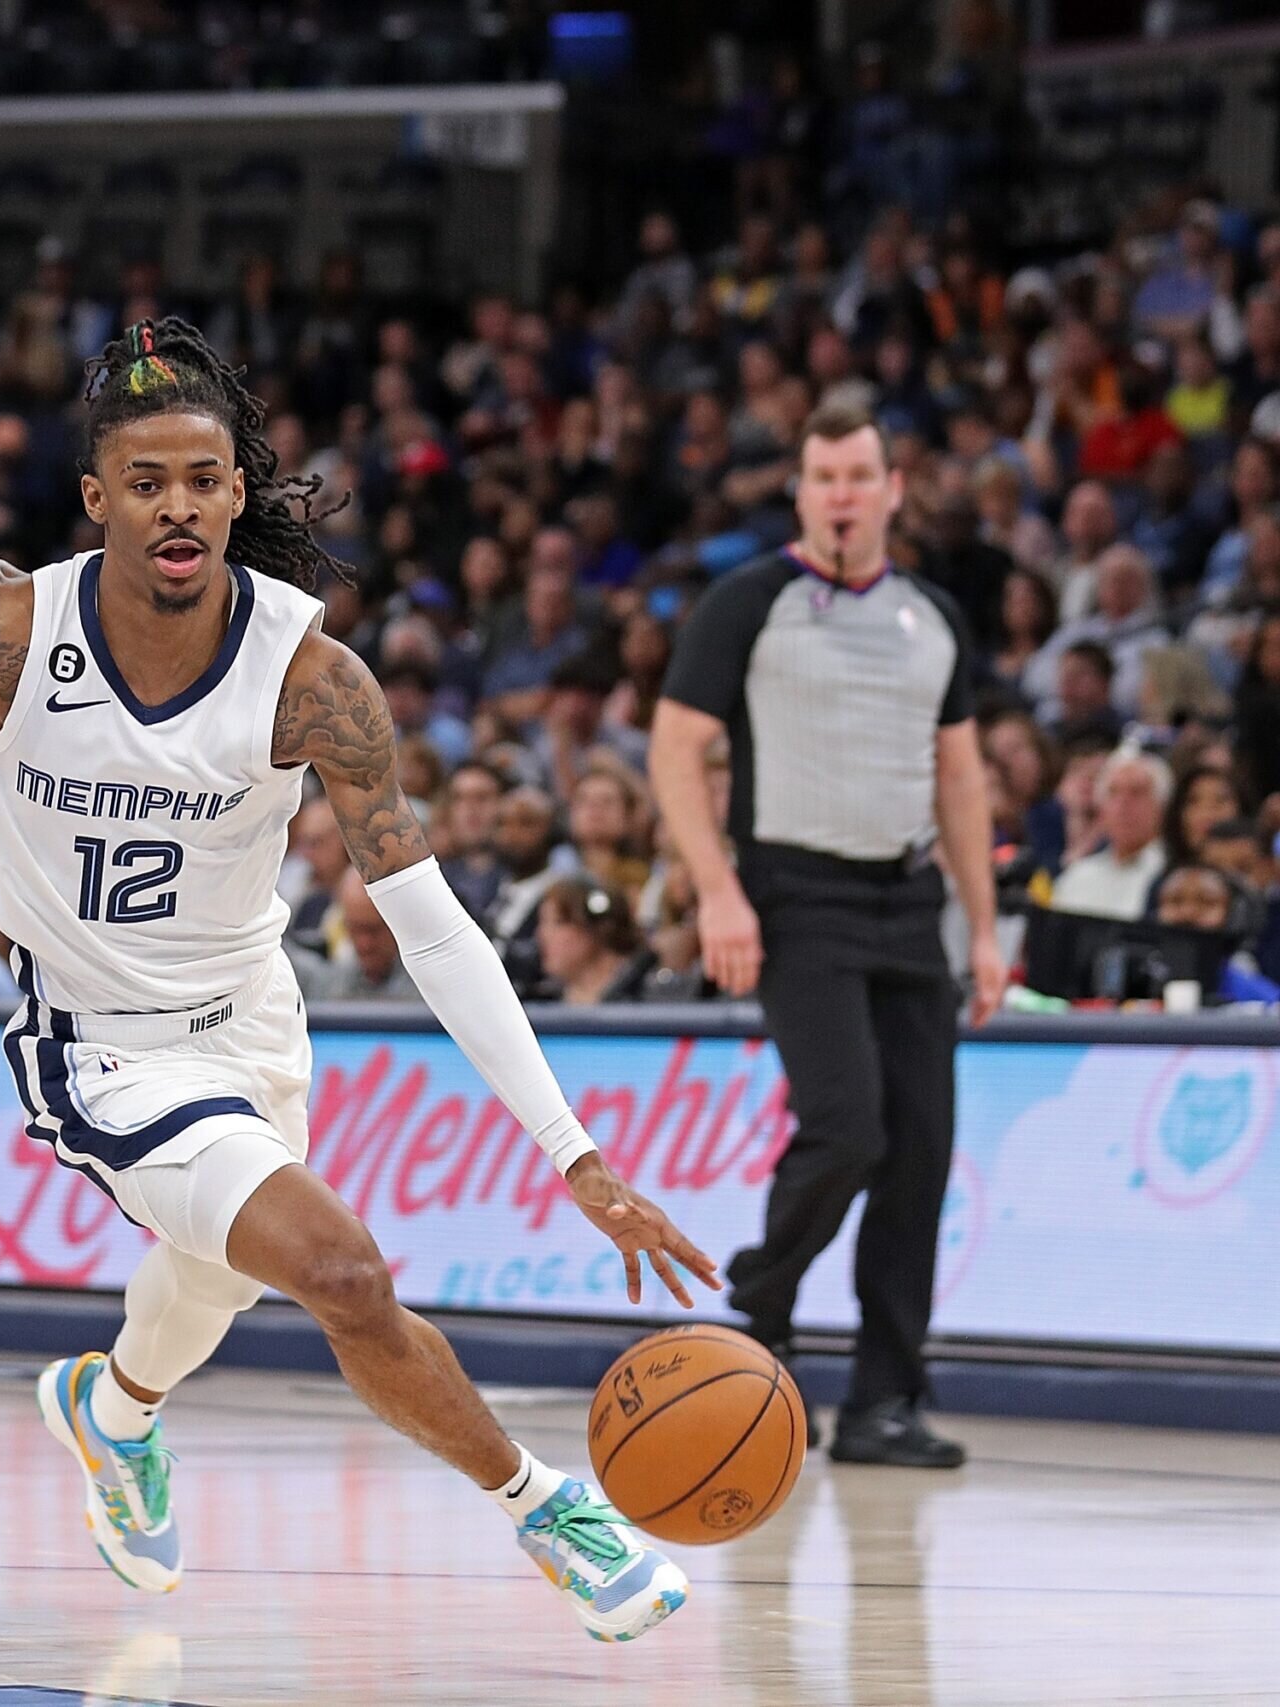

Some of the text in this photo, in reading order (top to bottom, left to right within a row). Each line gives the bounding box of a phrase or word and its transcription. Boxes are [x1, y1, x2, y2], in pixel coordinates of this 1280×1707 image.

[58, 648, 79, 679] 6
[16, 760, 254, 821] MEMPHIS
[73, 835, 184, 924] 12
